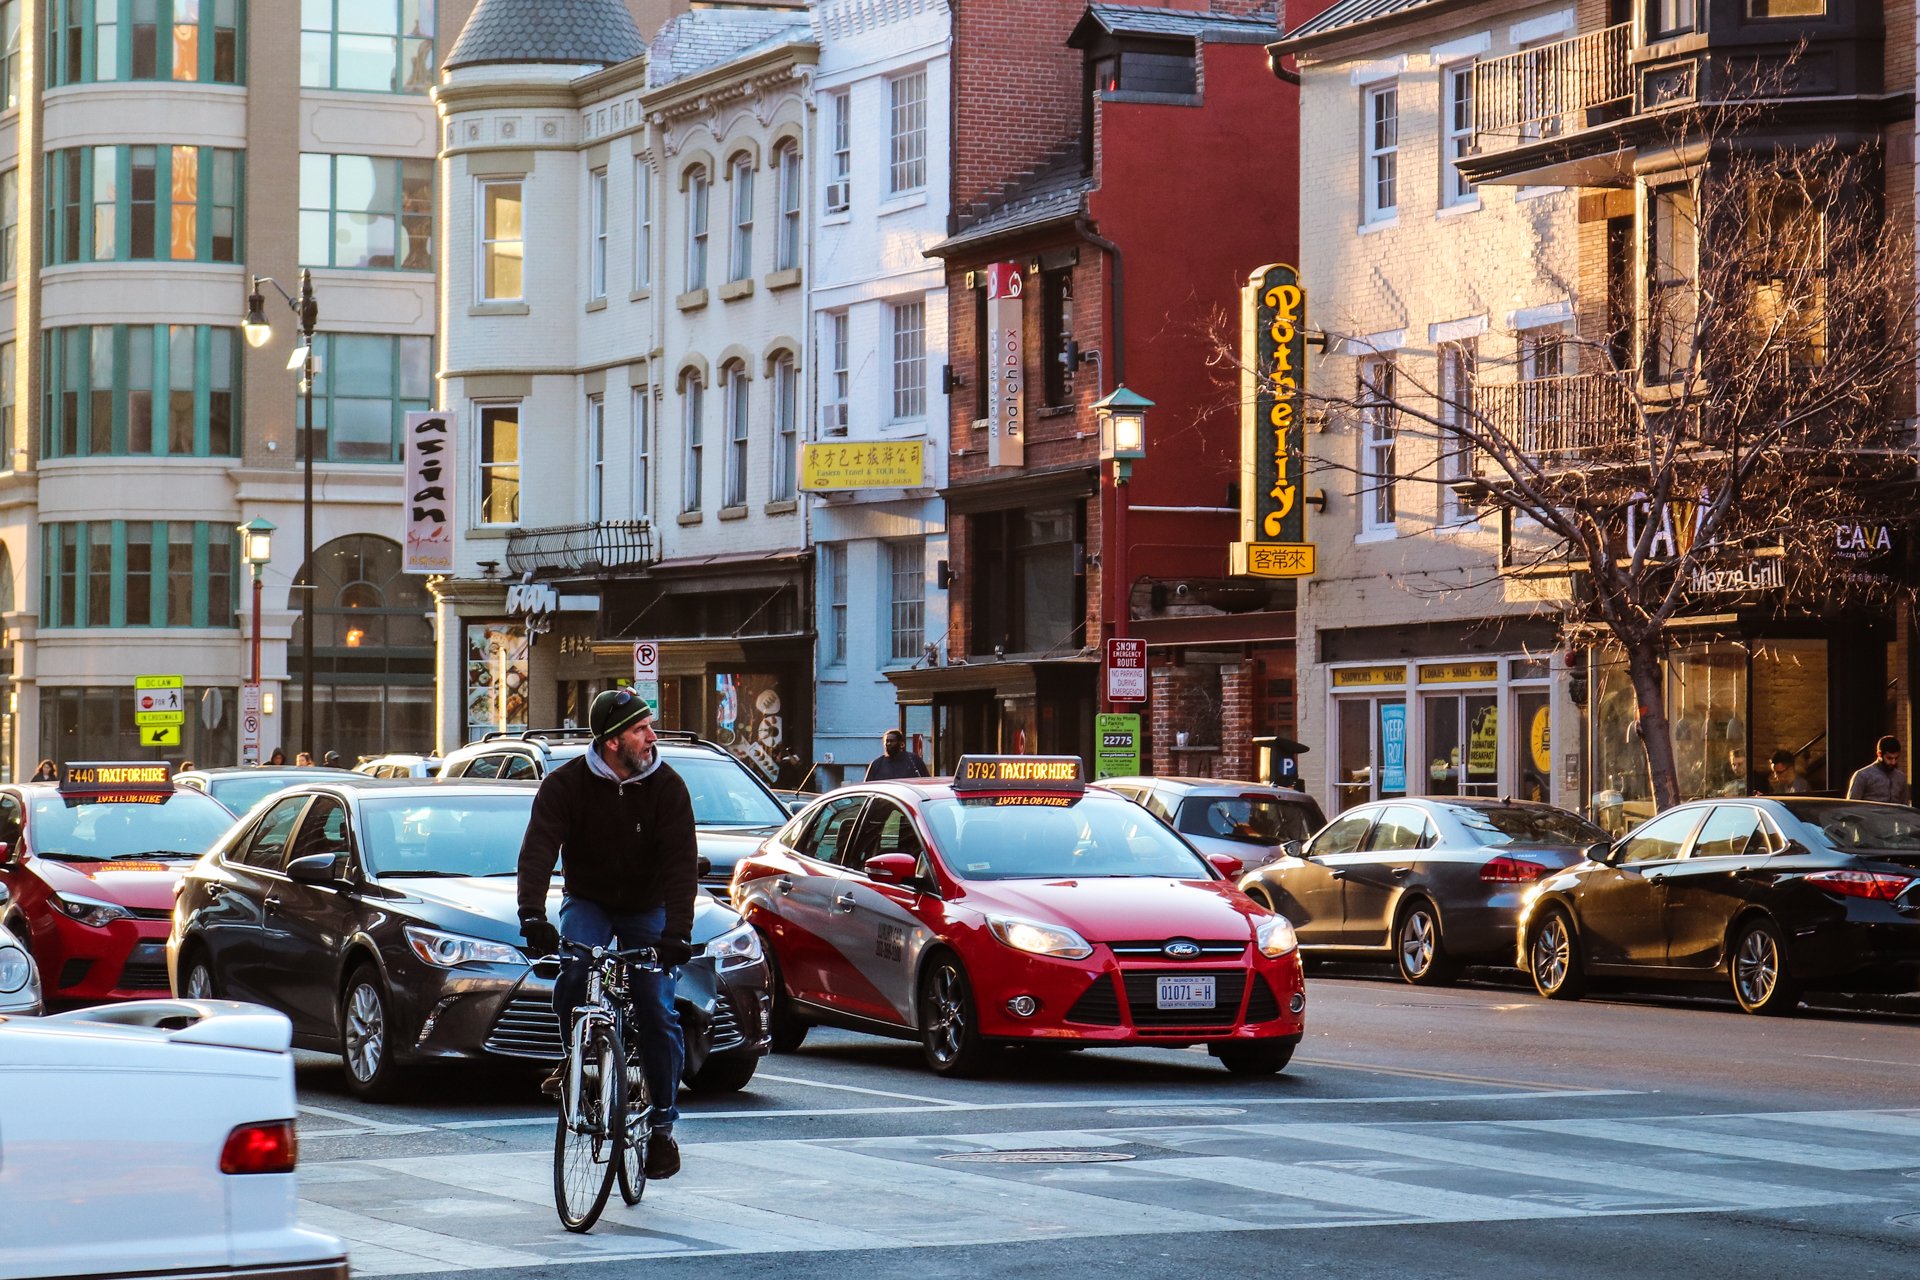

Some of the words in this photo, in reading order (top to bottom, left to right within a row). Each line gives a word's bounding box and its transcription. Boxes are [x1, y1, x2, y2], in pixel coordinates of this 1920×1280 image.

[1005, 329, 1018, 436] matchbox
[1264, 284, 1301, 537] Potbelly
[413, 418, 447, 523] asian
[1836, 525, 1892, 549] CAVA
[1254, 549, 1306, 570] 客常來
[1692, 565, 1744, 593] Mezze
[1749, 558, 1785, 590] Grill
[1116, 642, 1137, 651] SNOW
[1117, 658, 1137, 667] ROUTE
[1341, 671, 1371, 682] SANDWICHES
[1383, 670, 1404, 681] SALADS
[1424, 668, 1445, 679] COOKIES
[1452, 667, 1472, 678] SHAKES
[1479, 666, 1498, 677] SOUPS
[1118, 679, 1136, 687] DURING
[1485, 727, 1495, 736] NEW
[1103, 736, 1132, 745] 22775
[1471, 740, 1496, 750] SIGNATURE
[1470, 751, 1494, 760] BREAKFAST
[966, 763, 996, 779] B792
[1284, 758, 1294, 775] P
[68, 769, 94, 783] F440
[1174, 945, 1193, 954] Ford
[1161, 985, 1191, 1000] 01071
[1204, 985, 1211, 1000] H
